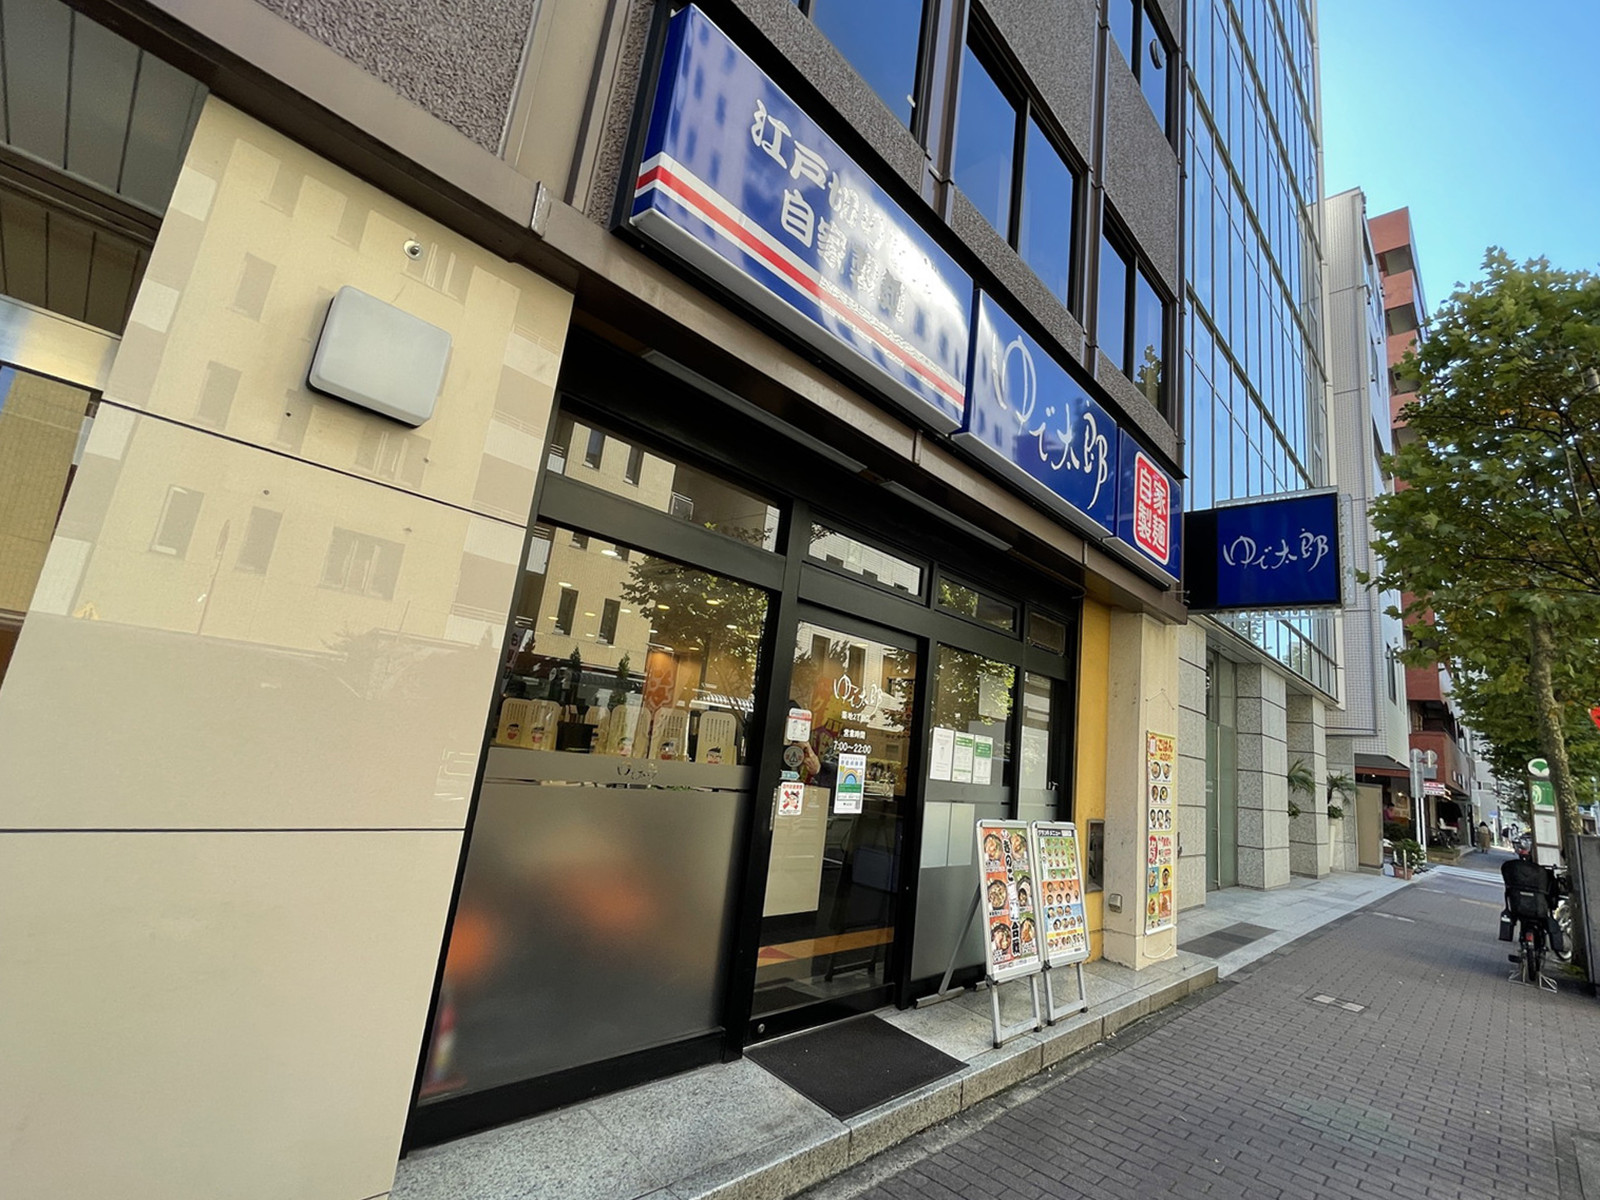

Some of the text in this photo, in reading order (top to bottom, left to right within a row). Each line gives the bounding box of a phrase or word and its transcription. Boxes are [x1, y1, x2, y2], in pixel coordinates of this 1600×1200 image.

[990, 332, 1111, 510] ゆで太郎
[1222, 527, 1330, 572] ゆで太郎
